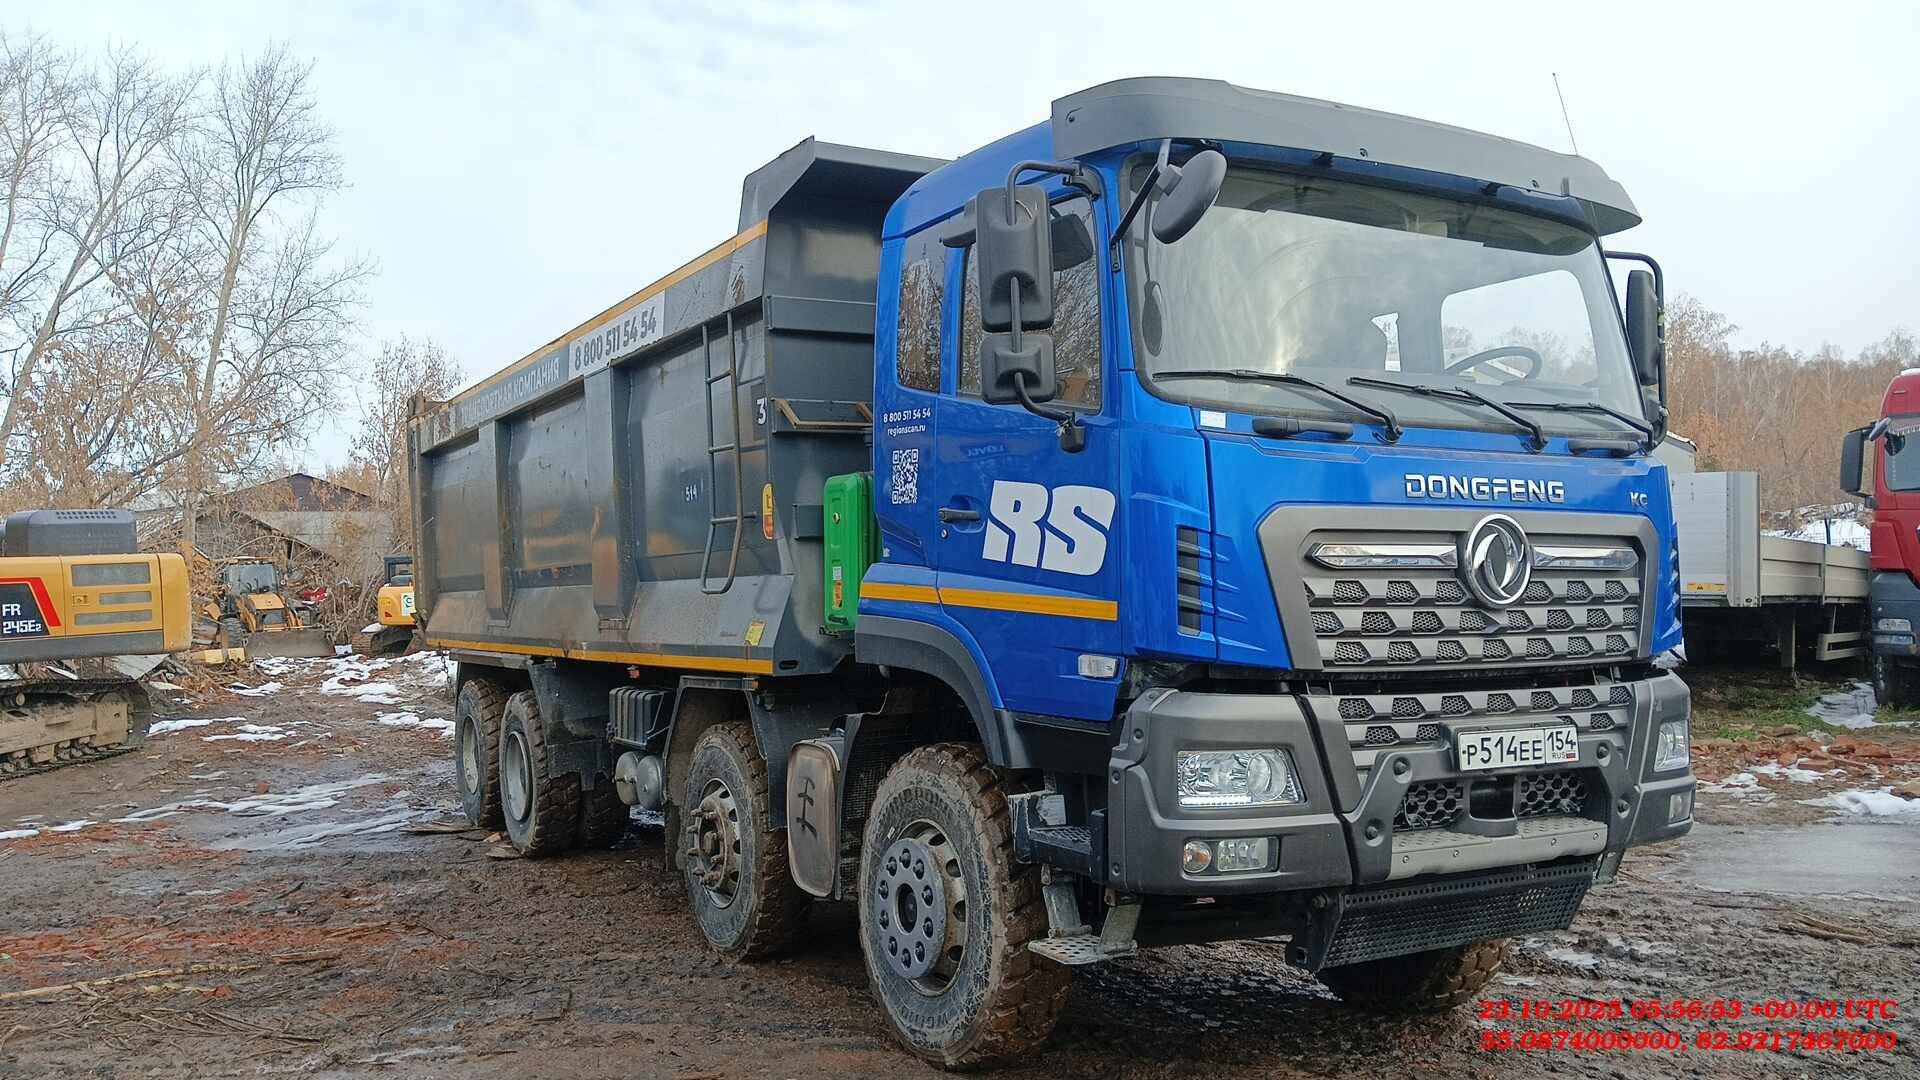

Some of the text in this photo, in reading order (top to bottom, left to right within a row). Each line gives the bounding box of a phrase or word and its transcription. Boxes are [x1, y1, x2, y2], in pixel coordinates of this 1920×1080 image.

[574, 306, 657, 371] 8 800 511 54 54
[513, 357, 560, 397] КОМПАНИЯ
[883, 408, 931, 423] 8 800 511 54 54
[887, 424, 926, 437] regionscan.ru
[685, 484, 698, 502] 514
[1404, 473, 1566, 503] DONGFENG
[982, 479, 1116, 576] RS
[2, 603, 21, 617] FR
[2, 619, 42, 634] 245E2
[1547, 730, 1577, 751] 154
[1551, 751, 1567, 760] RUS
